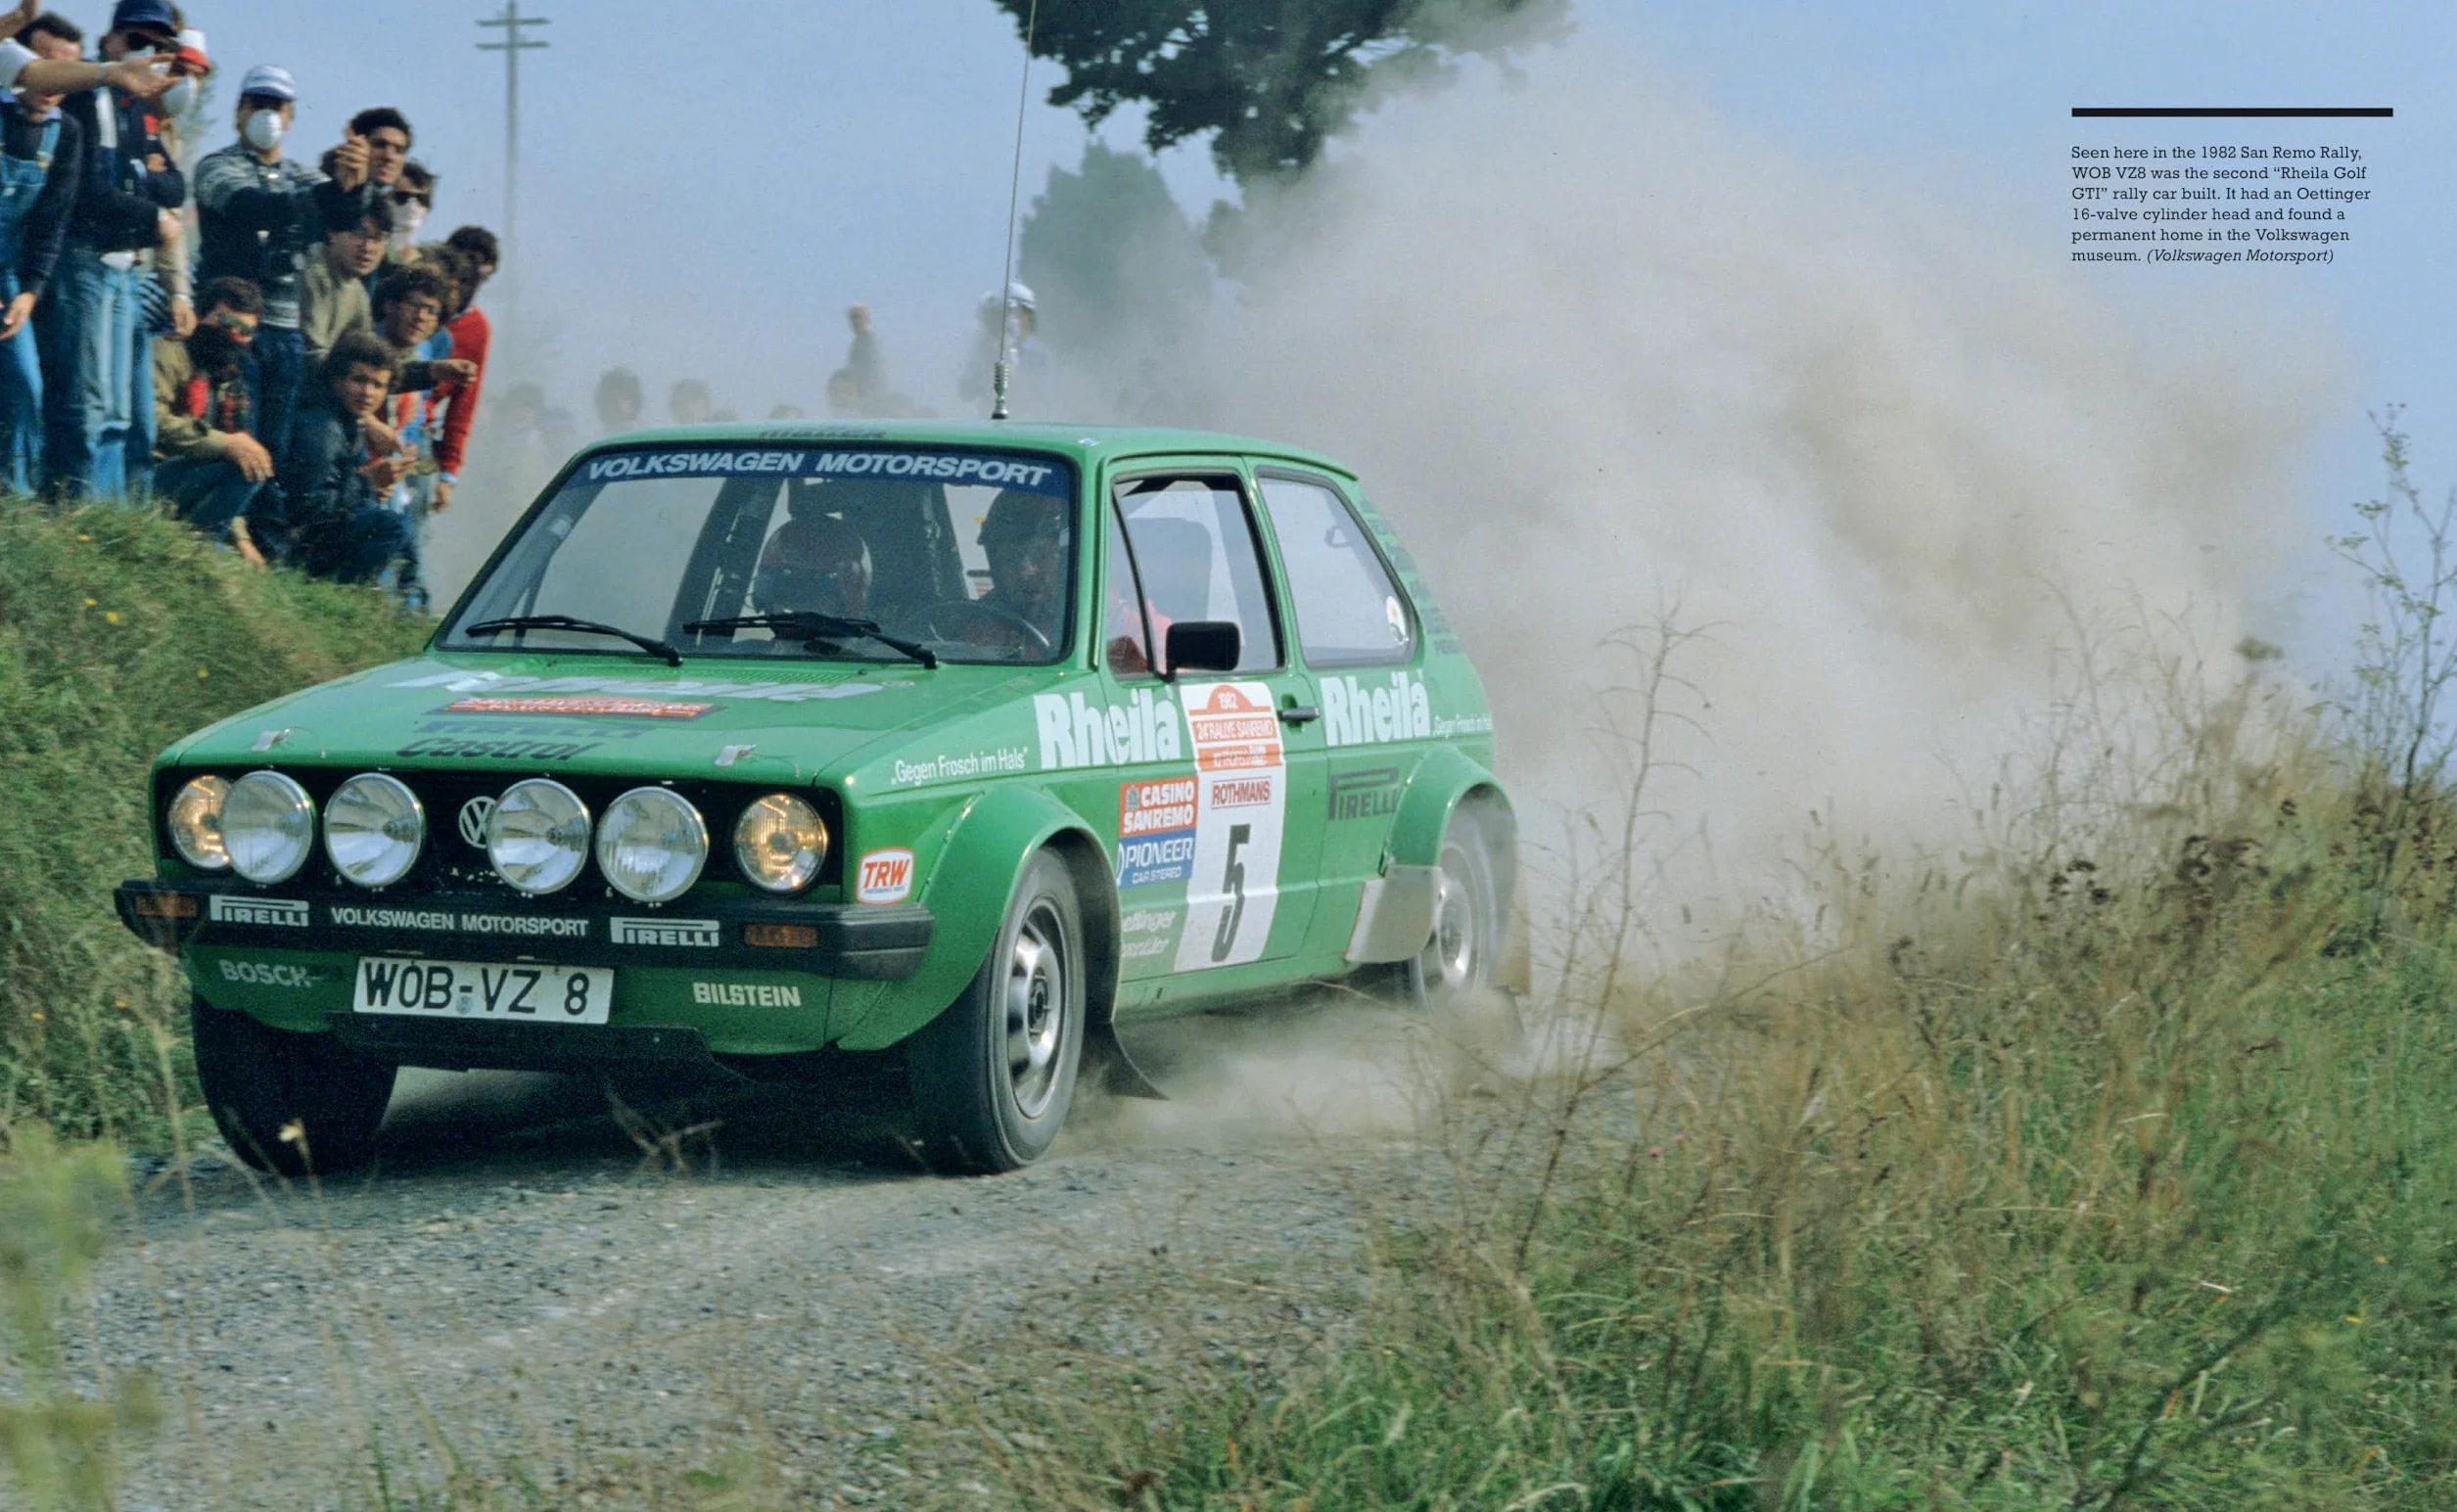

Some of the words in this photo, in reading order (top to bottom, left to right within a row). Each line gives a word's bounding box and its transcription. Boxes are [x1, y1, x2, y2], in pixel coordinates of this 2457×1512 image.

[587, 450, 805, 481] VOLKSWAGEN
[814, 452, 1053, 488] MOTORSPORT
[1320, 669, 1431, 747] Rheila
[1033, 686, 1181, 770] Rheila
[938, 755, 979, 777] Frosch
[980, 751, 997, 771] im
[1140, 780, 1194, 807] CASINO
[1212, 781, 1271, 805] ROTHMANS
[1328, 767, 1399, 822] PIRELLI
[1123, 803, 1194, 834] SANREMO
[1125, 838, 1194, 869] PIONEER
[862, 858, 911, 890] TRW
[1211, 824, 1251, 963] 5
[209, 894, 309, 927] PIRELLI
[331, 907, 454, 930] VOLKSWAGEN
[461, 914, 589, 937] MOTORSPORT
[610, 916, 720, 947] PIRELLI
[564, 972, 590, 1016] 8
[693, 982, 802, 1008] BILSTEIN
